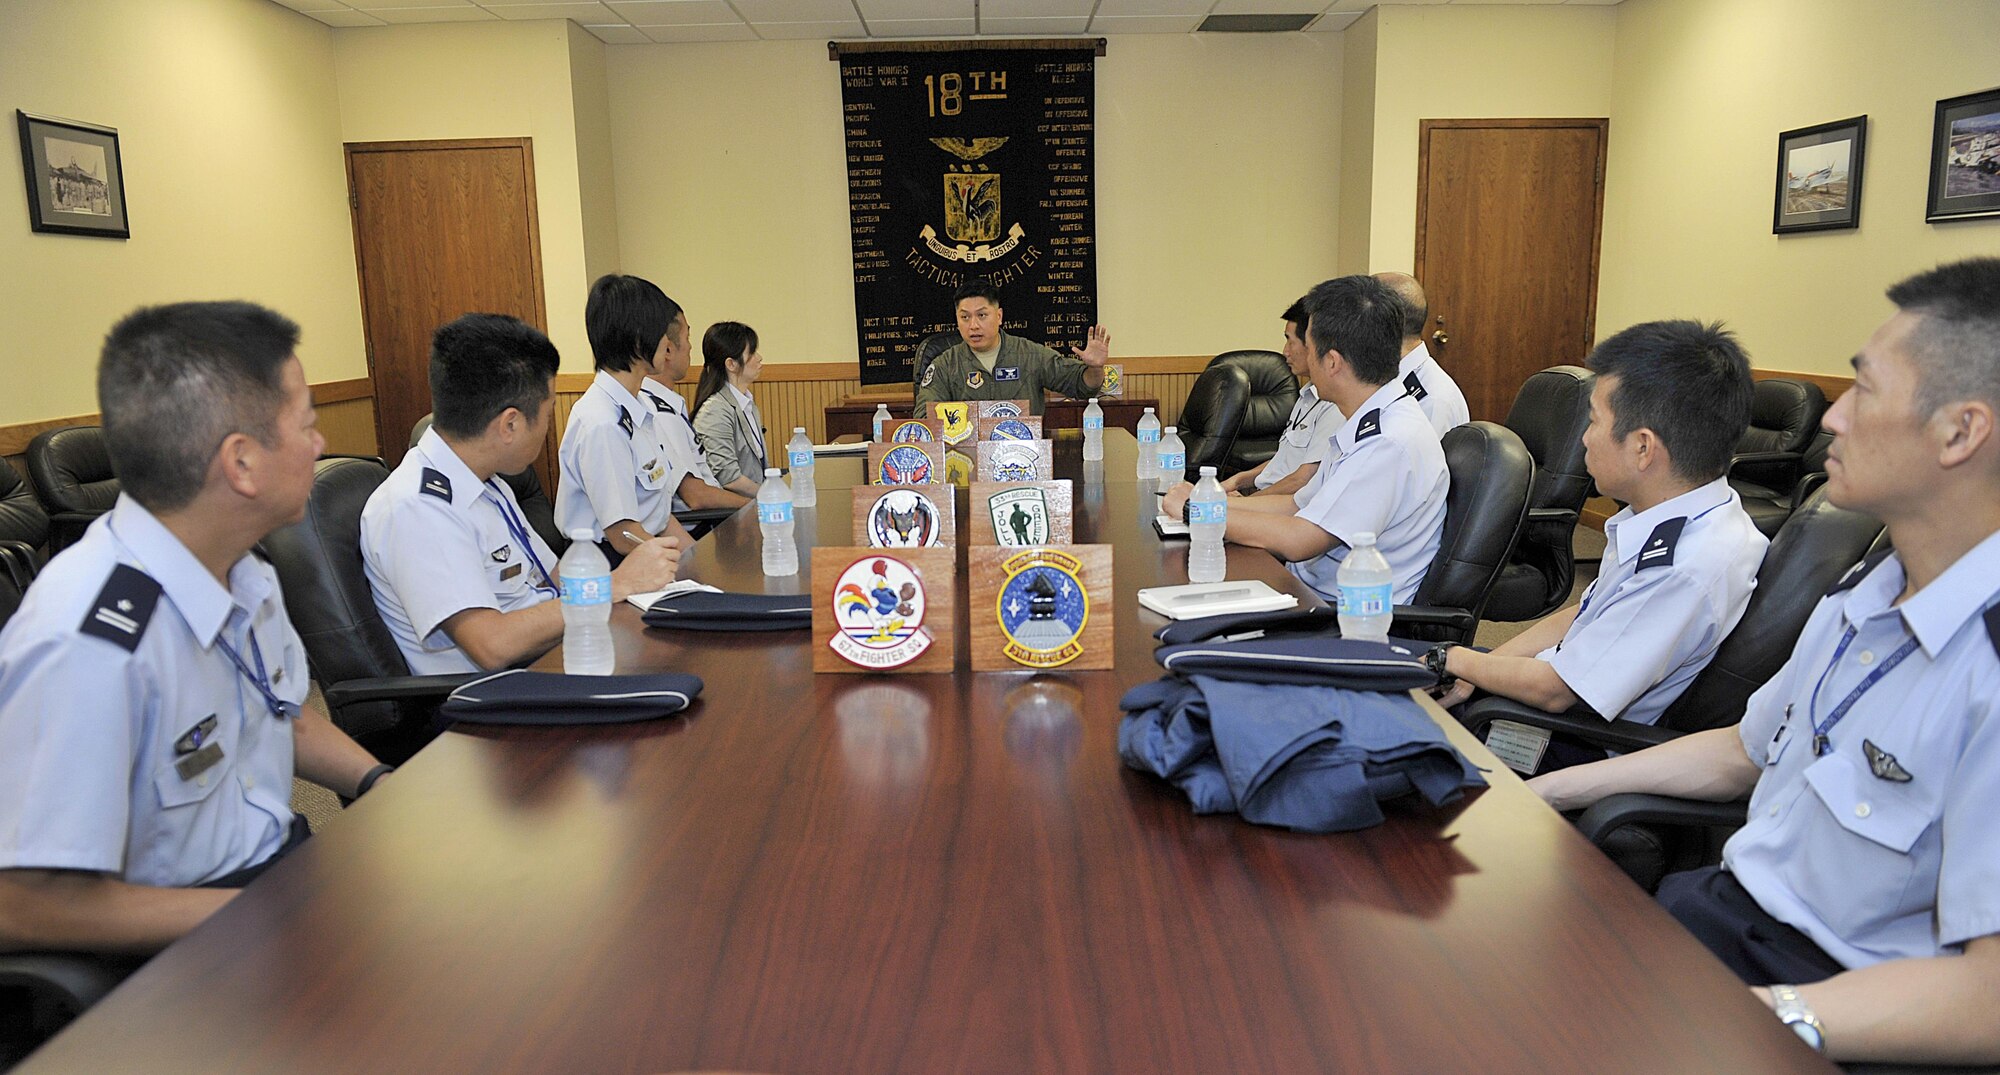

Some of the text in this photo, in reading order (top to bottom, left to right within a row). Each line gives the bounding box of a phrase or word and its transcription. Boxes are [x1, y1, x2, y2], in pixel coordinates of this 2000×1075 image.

[842, 65, 909, 76] BATTLE HONORS
[846, 78, 873, 87] WORLD
[880, 77, 897, 86] WAR
[924, 71, 1007, 117] 18TH
[845, 103, 875, 111] CENTRAL
[848, 140, 882, 148] OFFENSIVE
[928, 238, 1016, 261] UNGUIBUS ET ROSTRO
[856, 275, 876, 283] LEYTE
[1046, 325, 1063, 334] UNIT
[867, 359, 886, 367] KOREA
[1031, 504, 1042, 545] GREEN
[860, 648, 907, 664] FIGHTER
[907, 639, 922, 653] SQ
